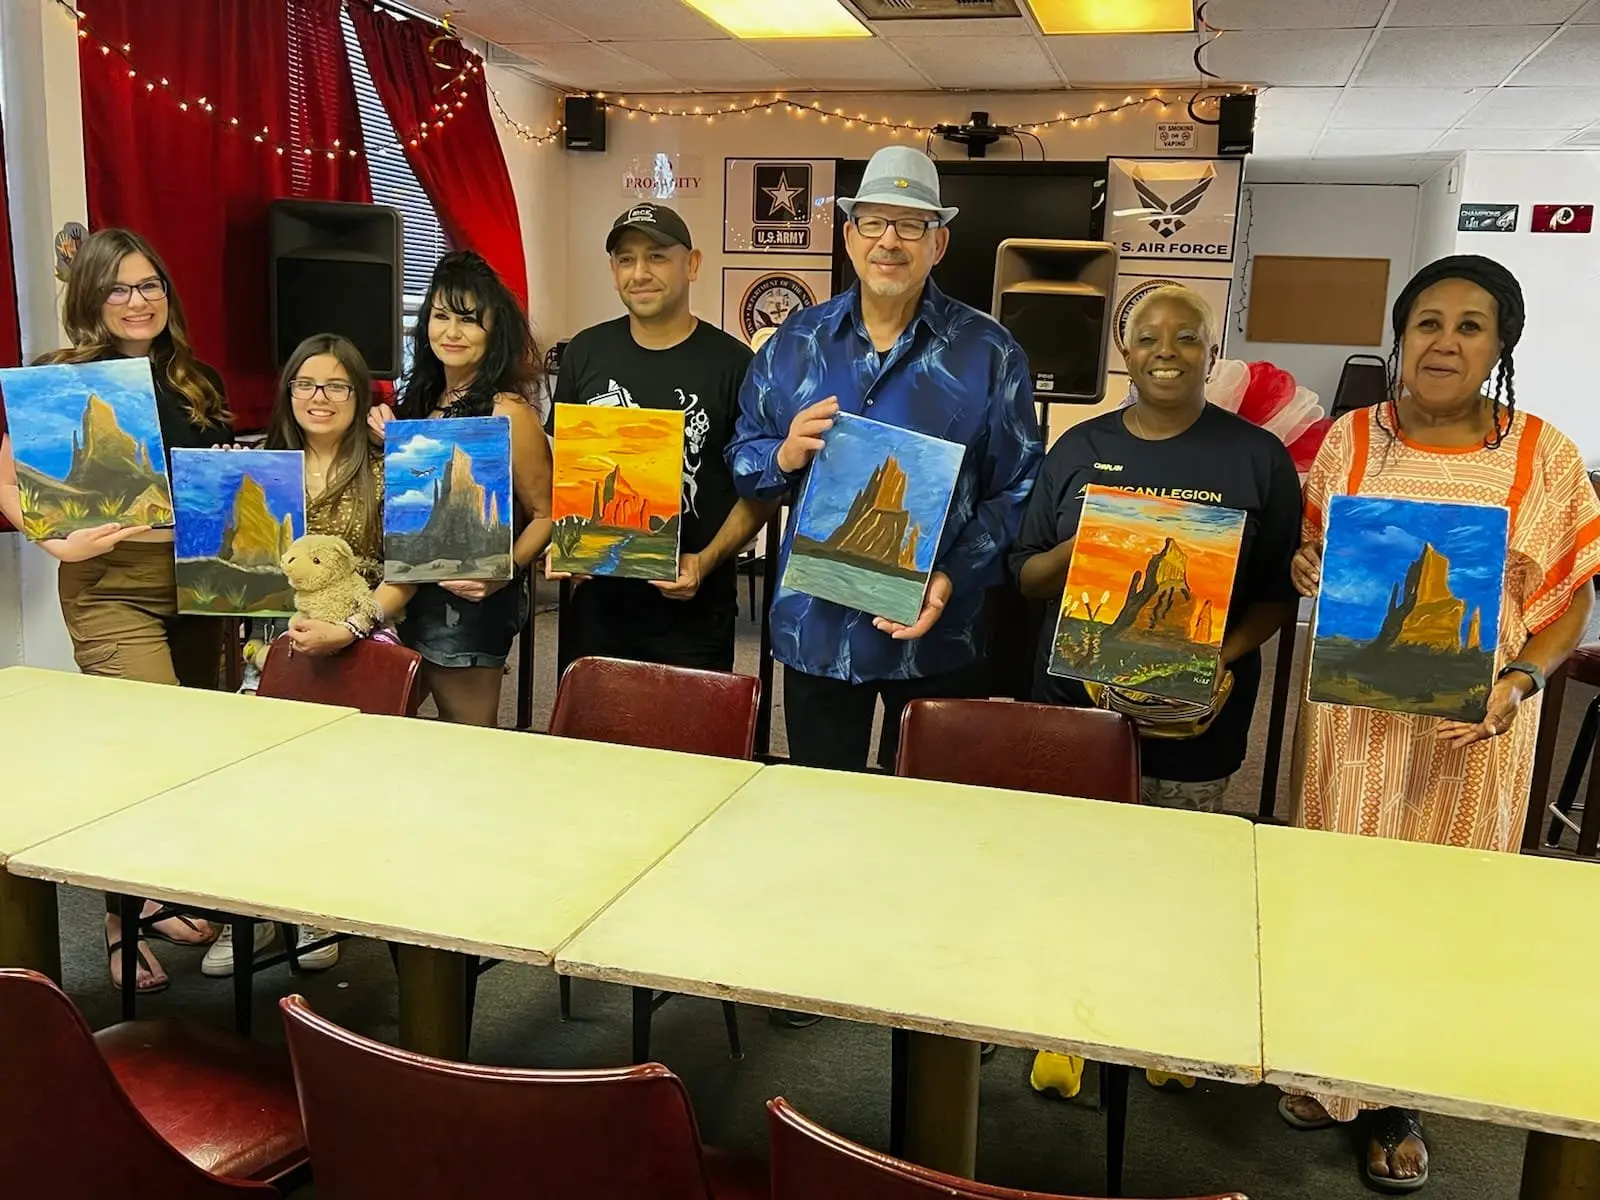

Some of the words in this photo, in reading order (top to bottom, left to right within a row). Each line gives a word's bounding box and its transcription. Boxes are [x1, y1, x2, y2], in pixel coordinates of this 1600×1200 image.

[1137, 243, 1165, 253] AIR
[1169, 244, 1228, 255] FORCE
[1160, 488, 1223, 503] LEGION
